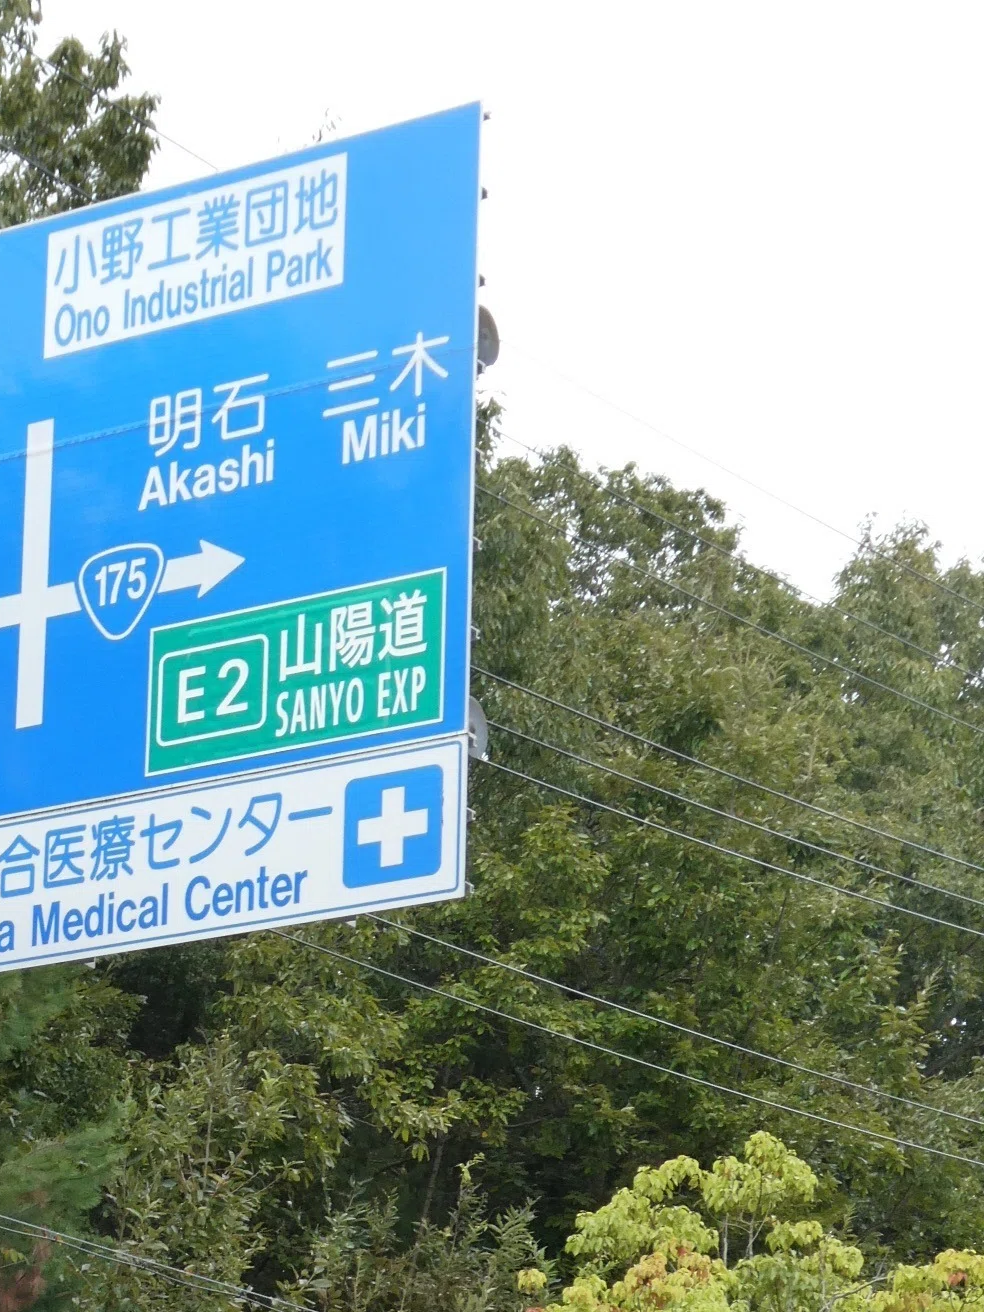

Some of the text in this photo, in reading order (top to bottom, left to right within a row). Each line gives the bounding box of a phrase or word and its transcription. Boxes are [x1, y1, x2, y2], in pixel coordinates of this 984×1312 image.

[53, 168, 338, 294] 小野工業団地
[54, 238, 334, 347] Ono Industrial Park
[148, 373, 269, 457] 明石
[322, 331, 450, 417] 三木
[137, 438, 275, 512] Akashi
[342, 402, 426, 465] Miki
[94, 557, 148, 607] 175
[279, 589, 428, 682] 山陽道
[275, 665, 427, 737] SANYO EXP
[31, 882, 169, 947] Medical
[184, 865, 308, 921] Center
